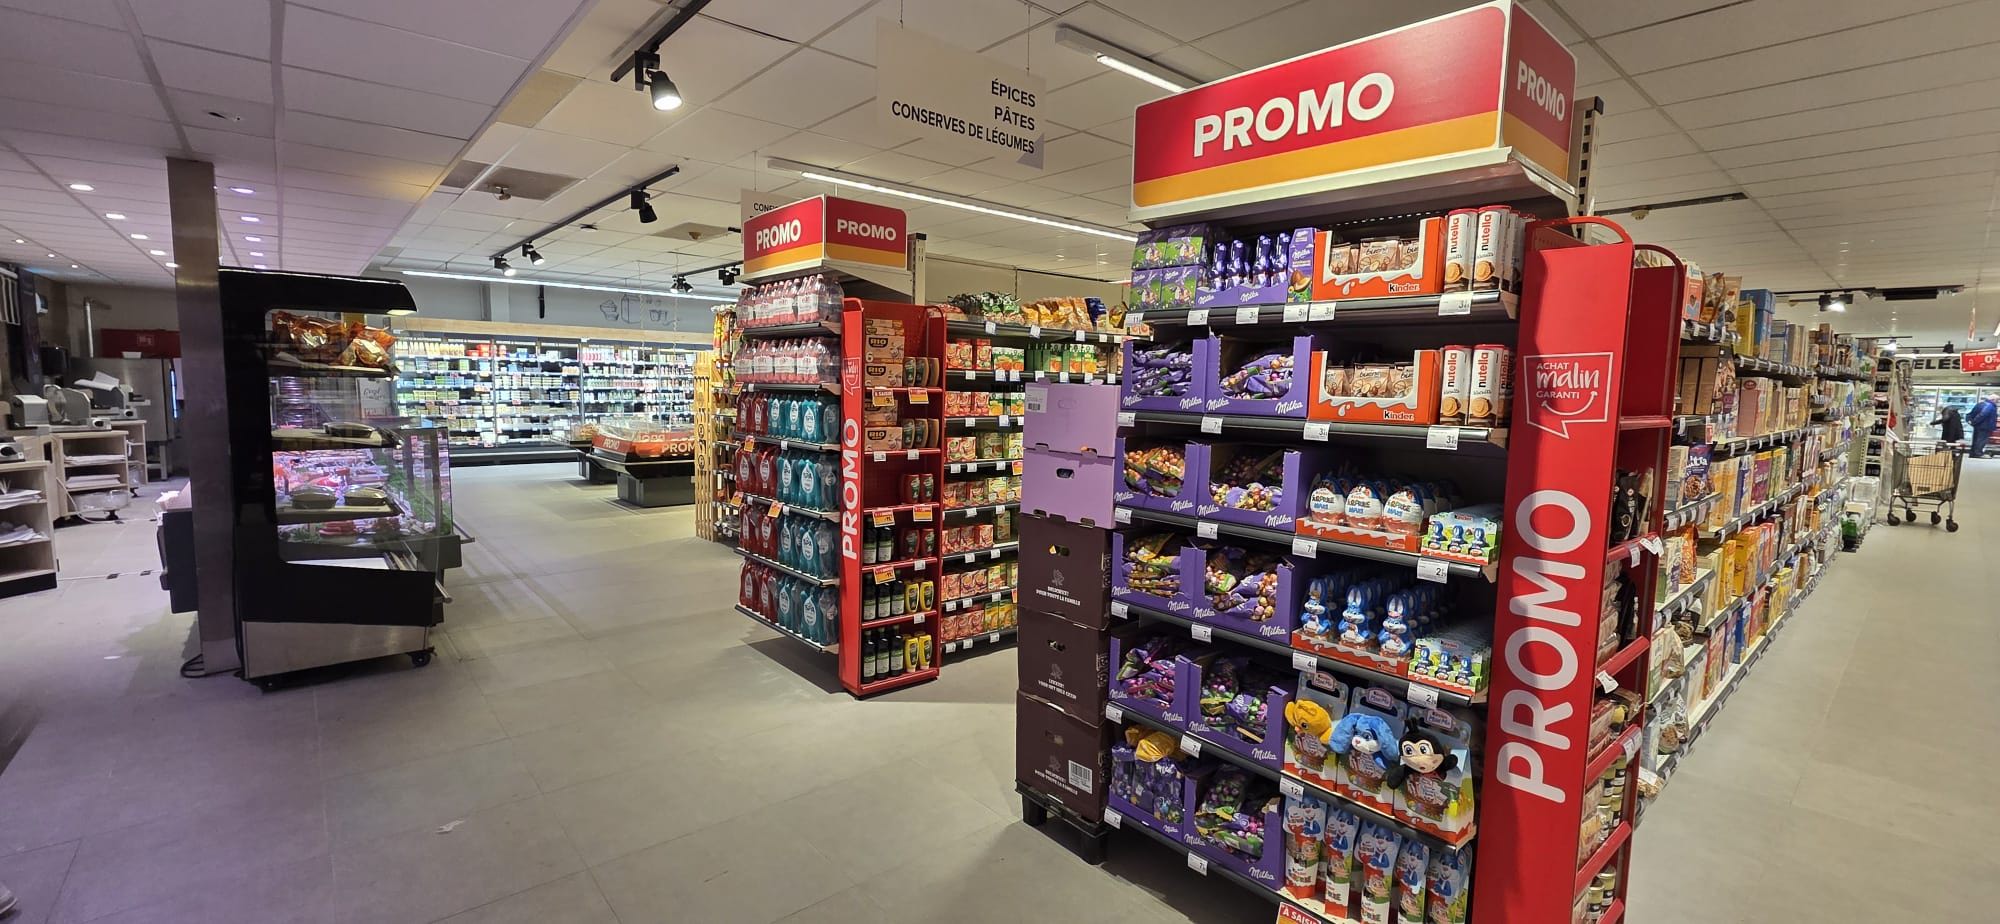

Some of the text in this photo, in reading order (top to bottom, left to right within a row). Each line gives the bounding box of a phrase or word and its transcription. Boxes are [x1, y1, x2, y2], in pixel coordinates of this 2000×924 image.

[991, 78, 1036, 108] ÉPICES
[1517, 60, 1566, 123] PROMO
[994, 106, 1035, 131] PÂTES
[1193, 72, 1395, 158] PROMO
[891, 100, 1035, 154] CONSERVES DE LÉGUMES
[753, 202, 778, 212] CONF
[756, 219, 801, 252] PROMO
[837, 218, 897, 241] PROMO
[1450, 217, 1460, 254] nutella
[1482, 214, 1492, 251] nutella
[1197, 293, 1215, 304] Milka
[1240, 291, 1260, 302] Milka
[865, 352, 874, 363] 6
[1447, 352, 1458, 388] nutella
[1479, 352, 1489, 388] nutella
[1536, 362, 1570, 370] ACHAT
[1536, 361, 1600, 389] malin
[1122, 395, 1143, 407] Milka
[1535, 390, 1580, 400] GARANTI
[1179, 396, 1203, 410] Milka
[1205, 398, 1230, 412] Milka
[1274, 400, 1304, 415] Milka
[1383, 410, 1415, 421] kinder
[868, 430, 885, 438] RIO
[661, 442, 695, 453] PROM
[842, 418, 859, 560] PROMO
[1113, 491, 1135, 502] Milka
[1170, 500, 1195, 512] Milka
[1196, 504, 1221, 516] Milka
[1264, 514, 1293, 527] Milka
[1111, 585, 1133, 596] Milka
[1167, 600, 1191, 612] Milka
[1192, 607, 1216, 619] Milka
[1259, 625, 1288, 636] Milka
[1496, 489, 1592, 805] PROMO
[1109, 688, 1129, 699] Milka
[1161, 711, 1185, 723] Milka
[1188, 721, 1211, 733] Milka
[1251, 748, 1278, 761] Milka
[1184, 833, 1207, 847] Milka
[1248, 866, 1276, 881] Milka
[1290, 911, 1318, 924] SAISI
